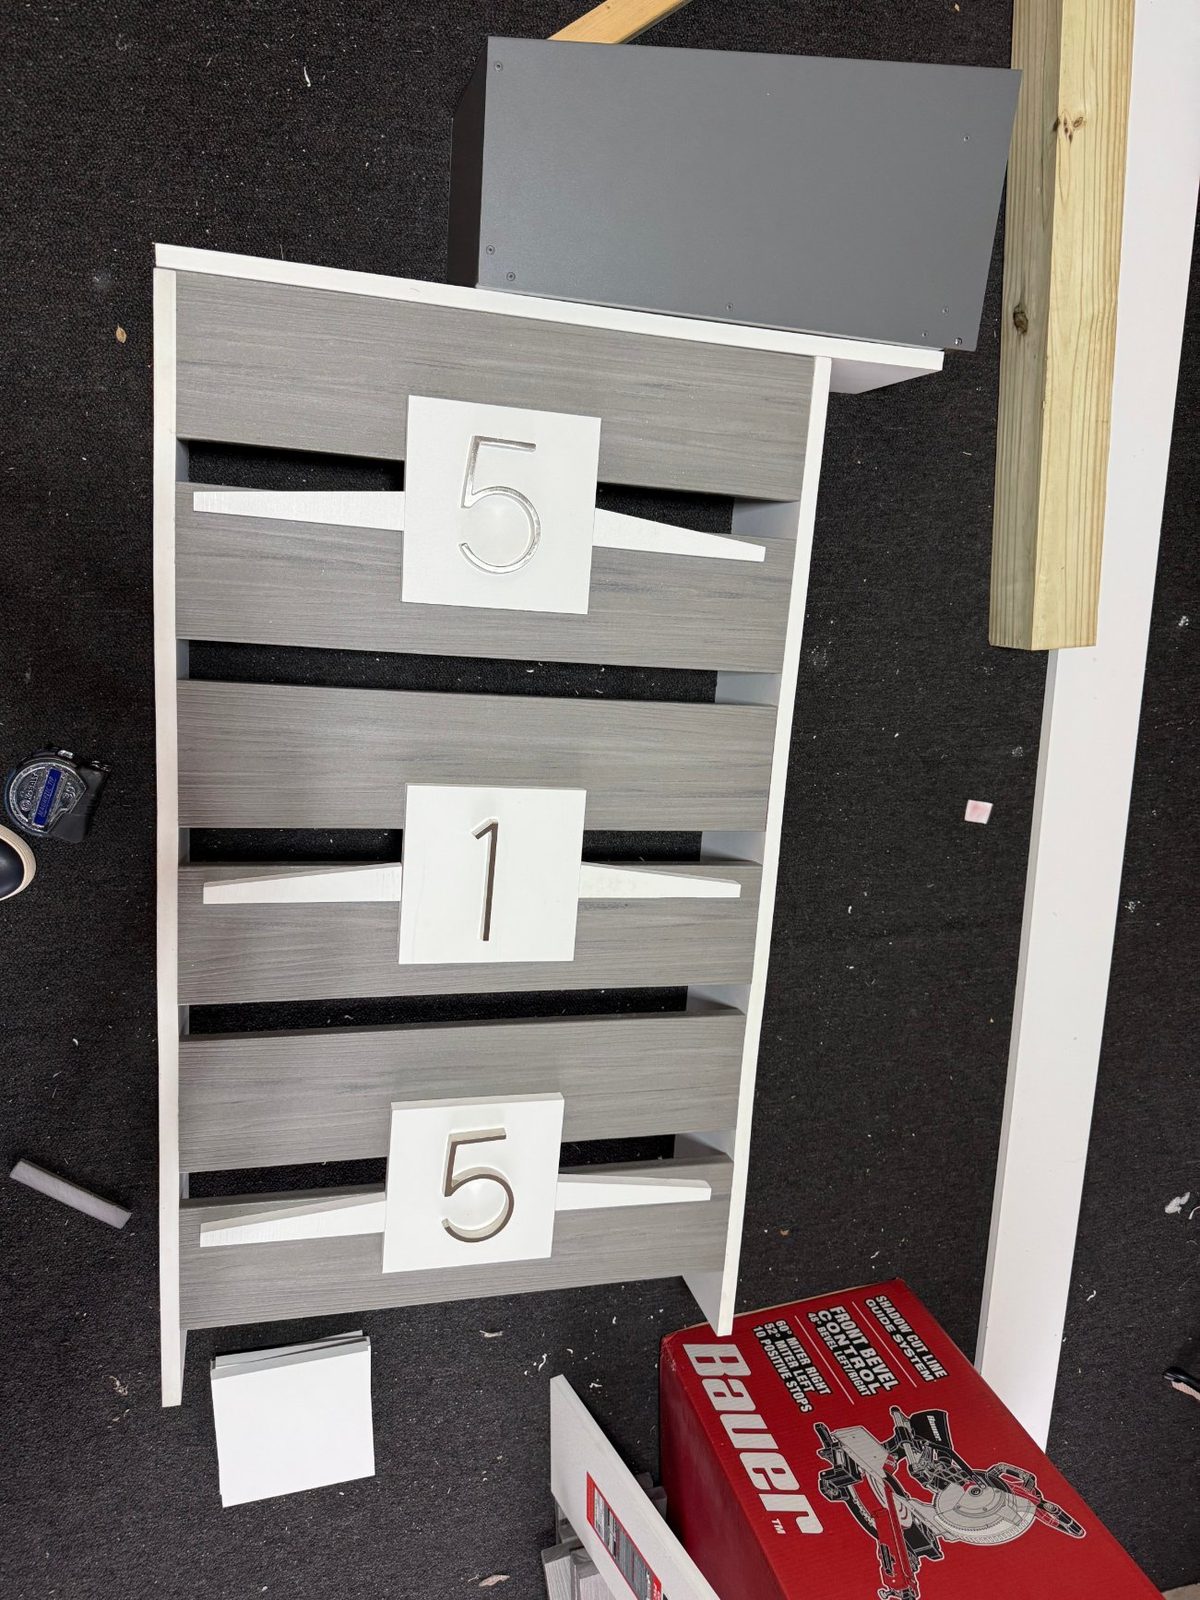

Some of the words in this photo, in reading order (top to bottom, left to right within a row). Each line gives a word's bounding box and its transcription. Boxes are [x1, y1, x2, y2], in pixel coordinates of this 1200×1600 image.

[458, 435, 542, 574] 5
[470, 817, 499, 943] 1
[441, 1126, 516, 1244] 5
[753, 1325, 767, 1338] 10
[760, 1339, 792, 1380] POSITIVE
[786, 1380, 813, 1413] STOPS
[764, 1323, 781, 1338] 52°
[774, 1339, 800, 1369] MITER
[793, 1369, 816, 1392] LEFT
[775, 1320, 792, 1335] 60°
[786, 1336, 812, 1366] MITER
[805, 1366, 832, 1394] RIGHT
[816, 1326, 838, 1351] BEVEL
[833, 1350, 872, 1396] LEFT/RIGHT
[817, 1310, 881, 1395] CONTROL
[829, 1306, 869, 1345] FRONT
[859, 1347, 899, 1391] BEVEL
[865, 1299, 896, 1333] GUIDE
[892, 1334, 934, 1382] SYSTEM
[875, 1295, 912, 1333] SHADOW
[906, 1334, 928, 1353] CUT
[921, 1354, 948, 1378] LINE
[682, 1343, 824, 1535] Bauer
